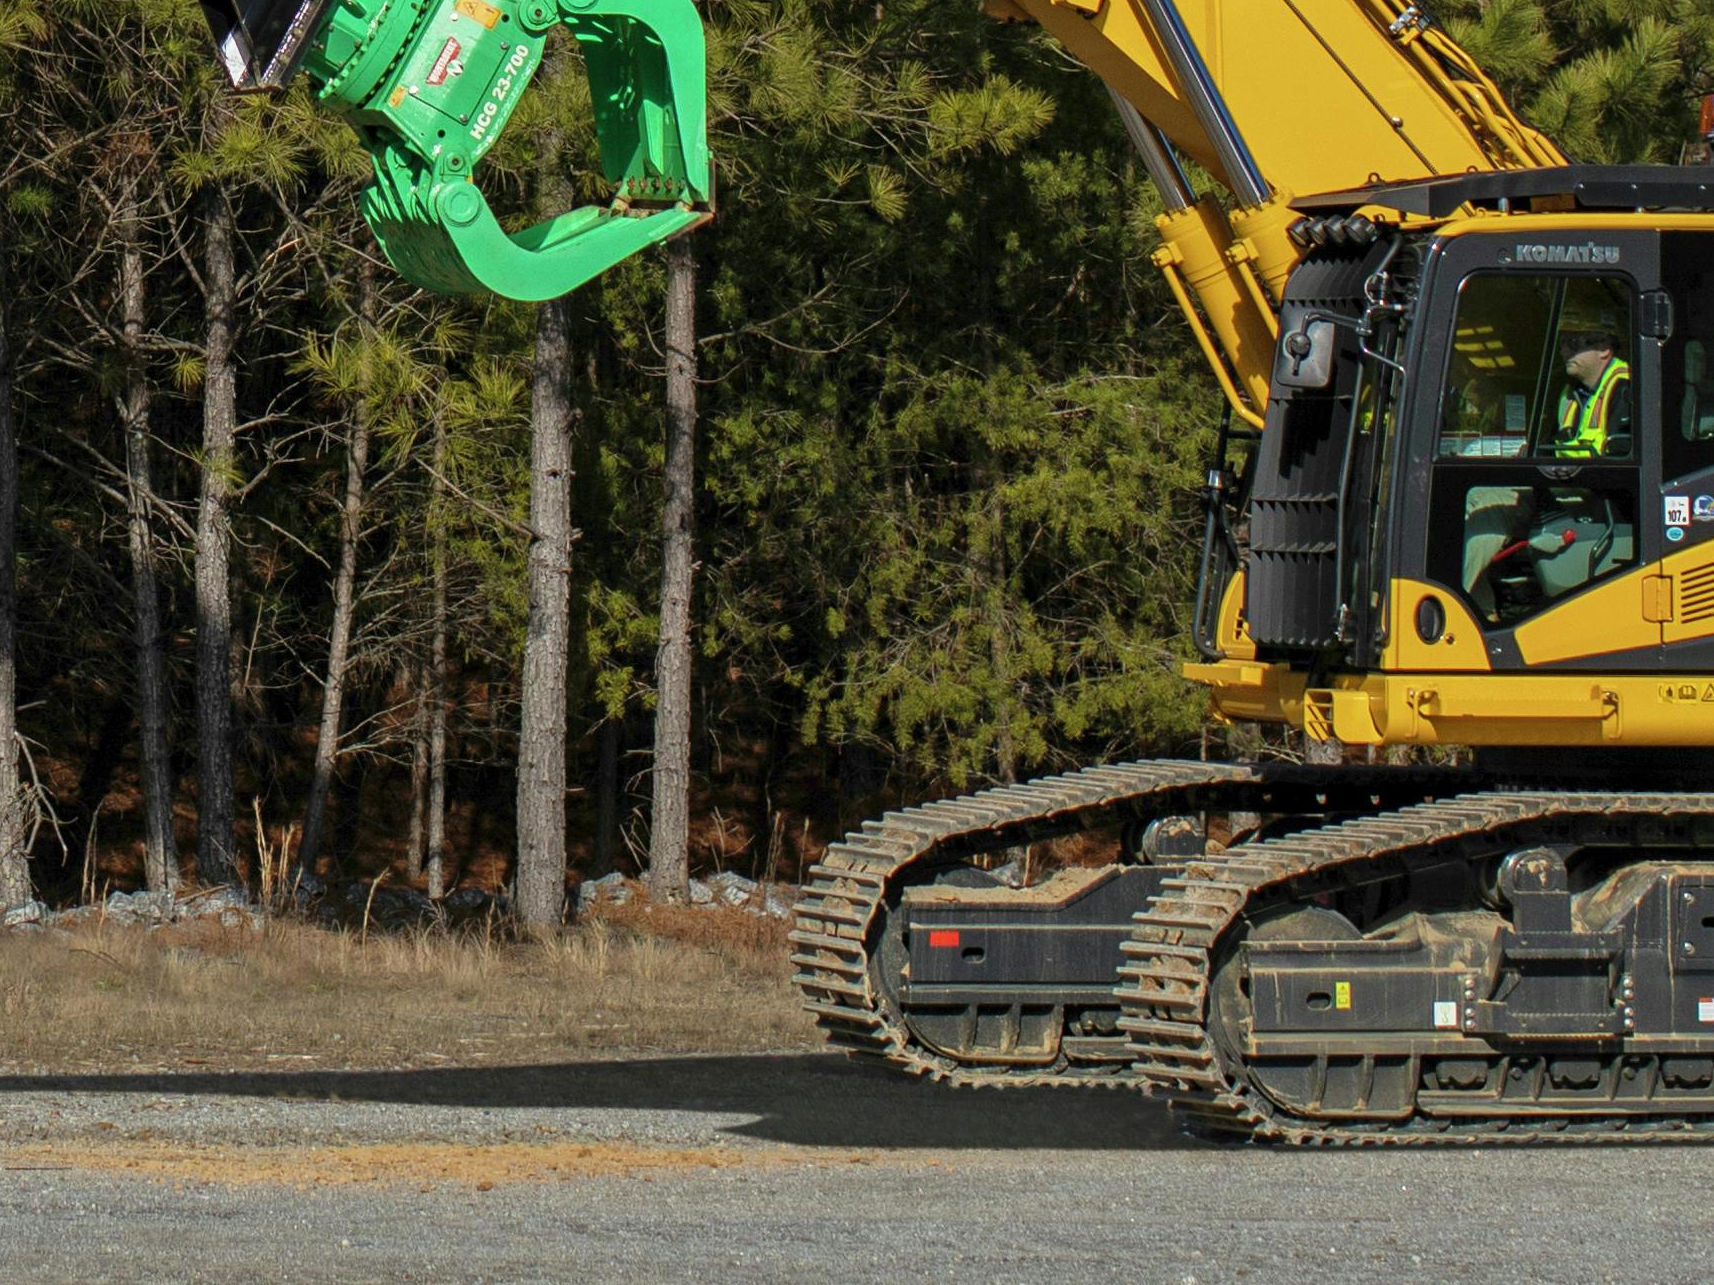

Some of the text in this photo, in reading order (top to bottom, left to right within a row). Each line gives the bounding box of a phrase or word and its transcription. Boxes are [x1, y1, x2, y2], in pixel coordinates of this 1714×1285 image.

[469, 45, 529, 140] HCG 23-700
[1516, 241, 1620, 264] KOMATSU
